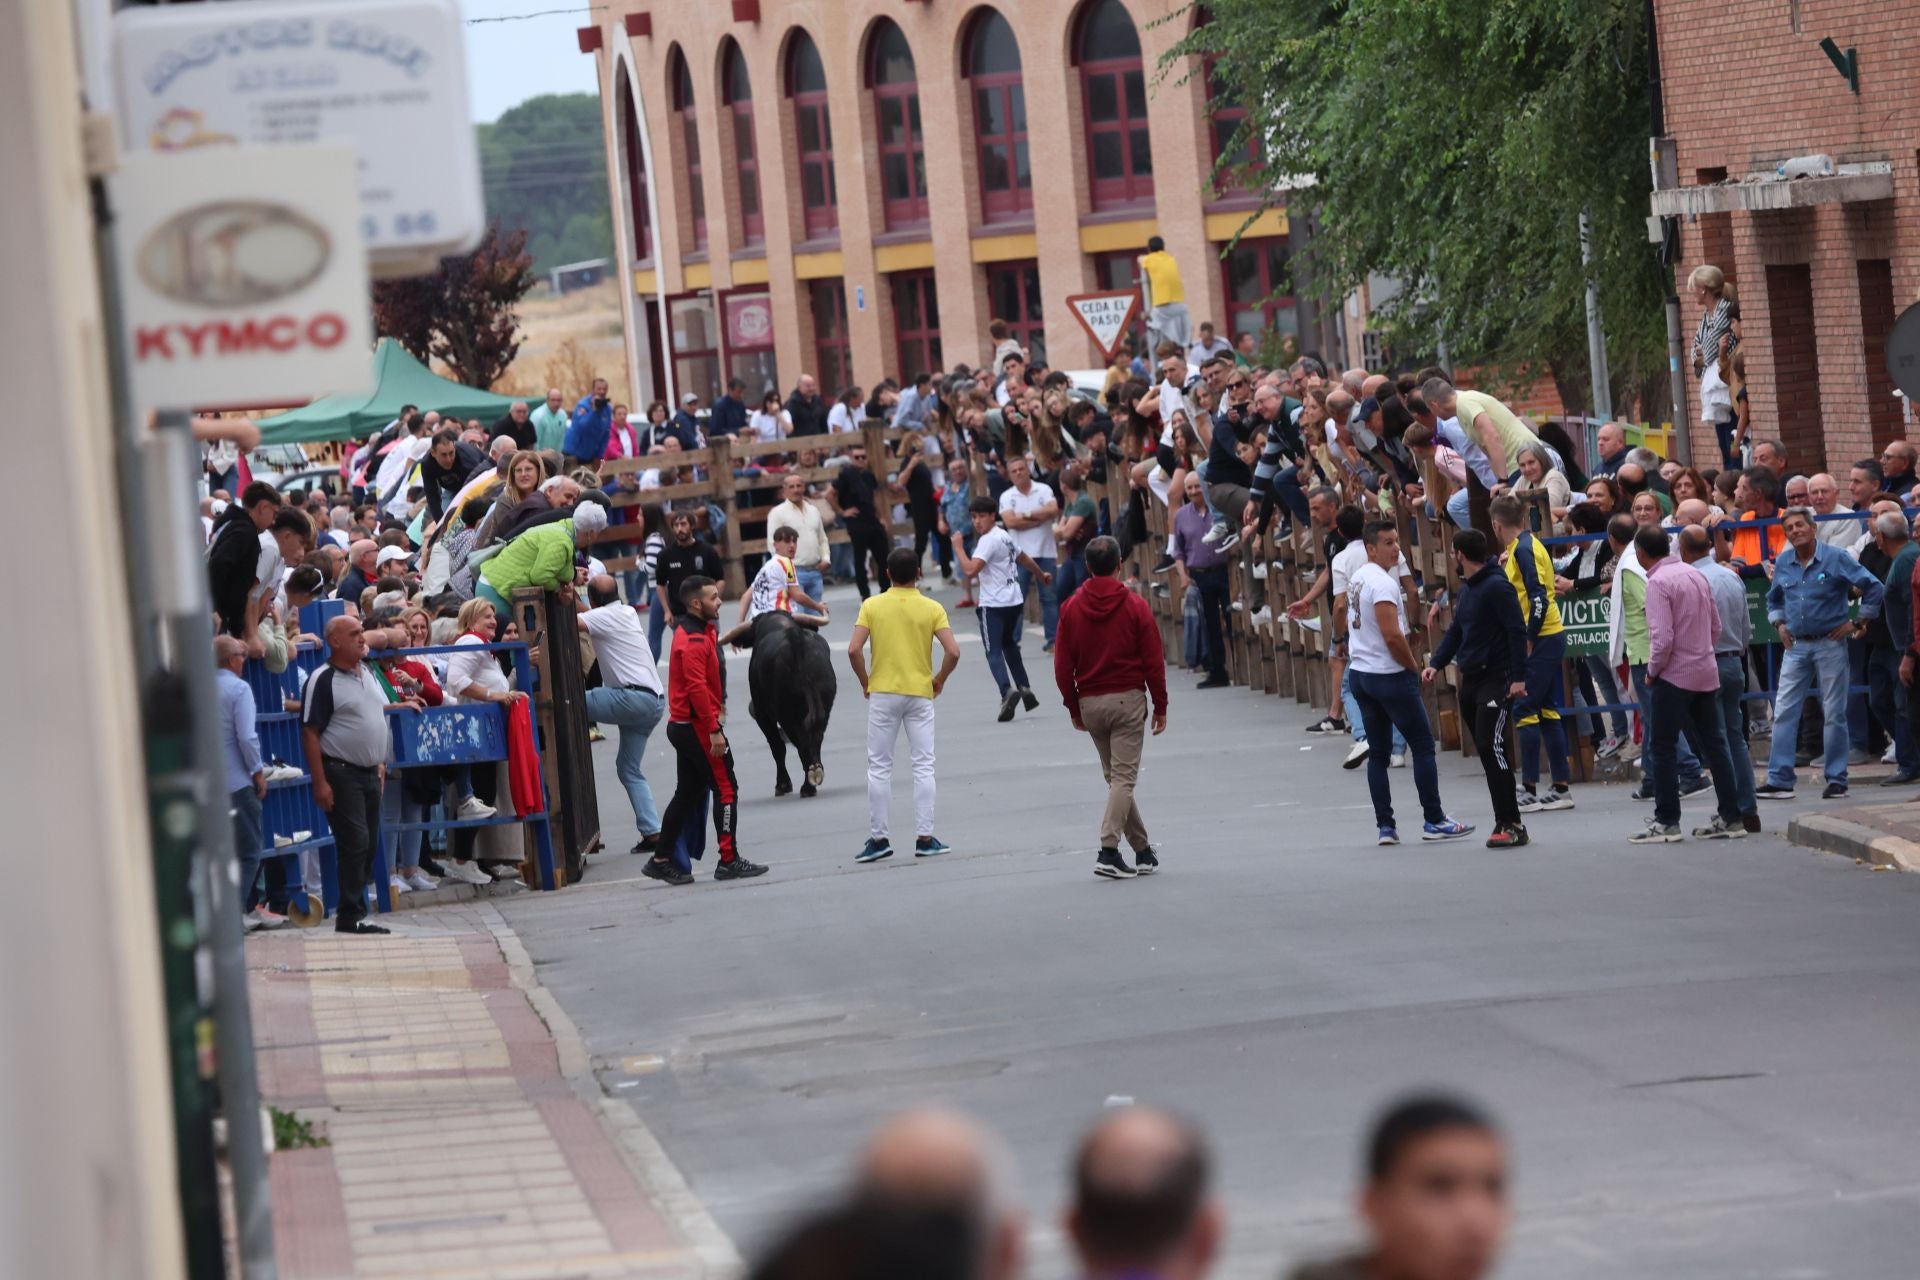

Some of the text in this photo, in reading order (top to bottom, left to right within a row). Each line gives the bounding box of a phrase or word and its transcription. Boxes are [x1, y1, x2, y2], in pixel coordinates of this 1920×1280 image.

[1081, 300, 1127, 313] CEDA EL
[1090, 314, 1121, 326] PASO
[133, 314, 347, 361] KYMCO
